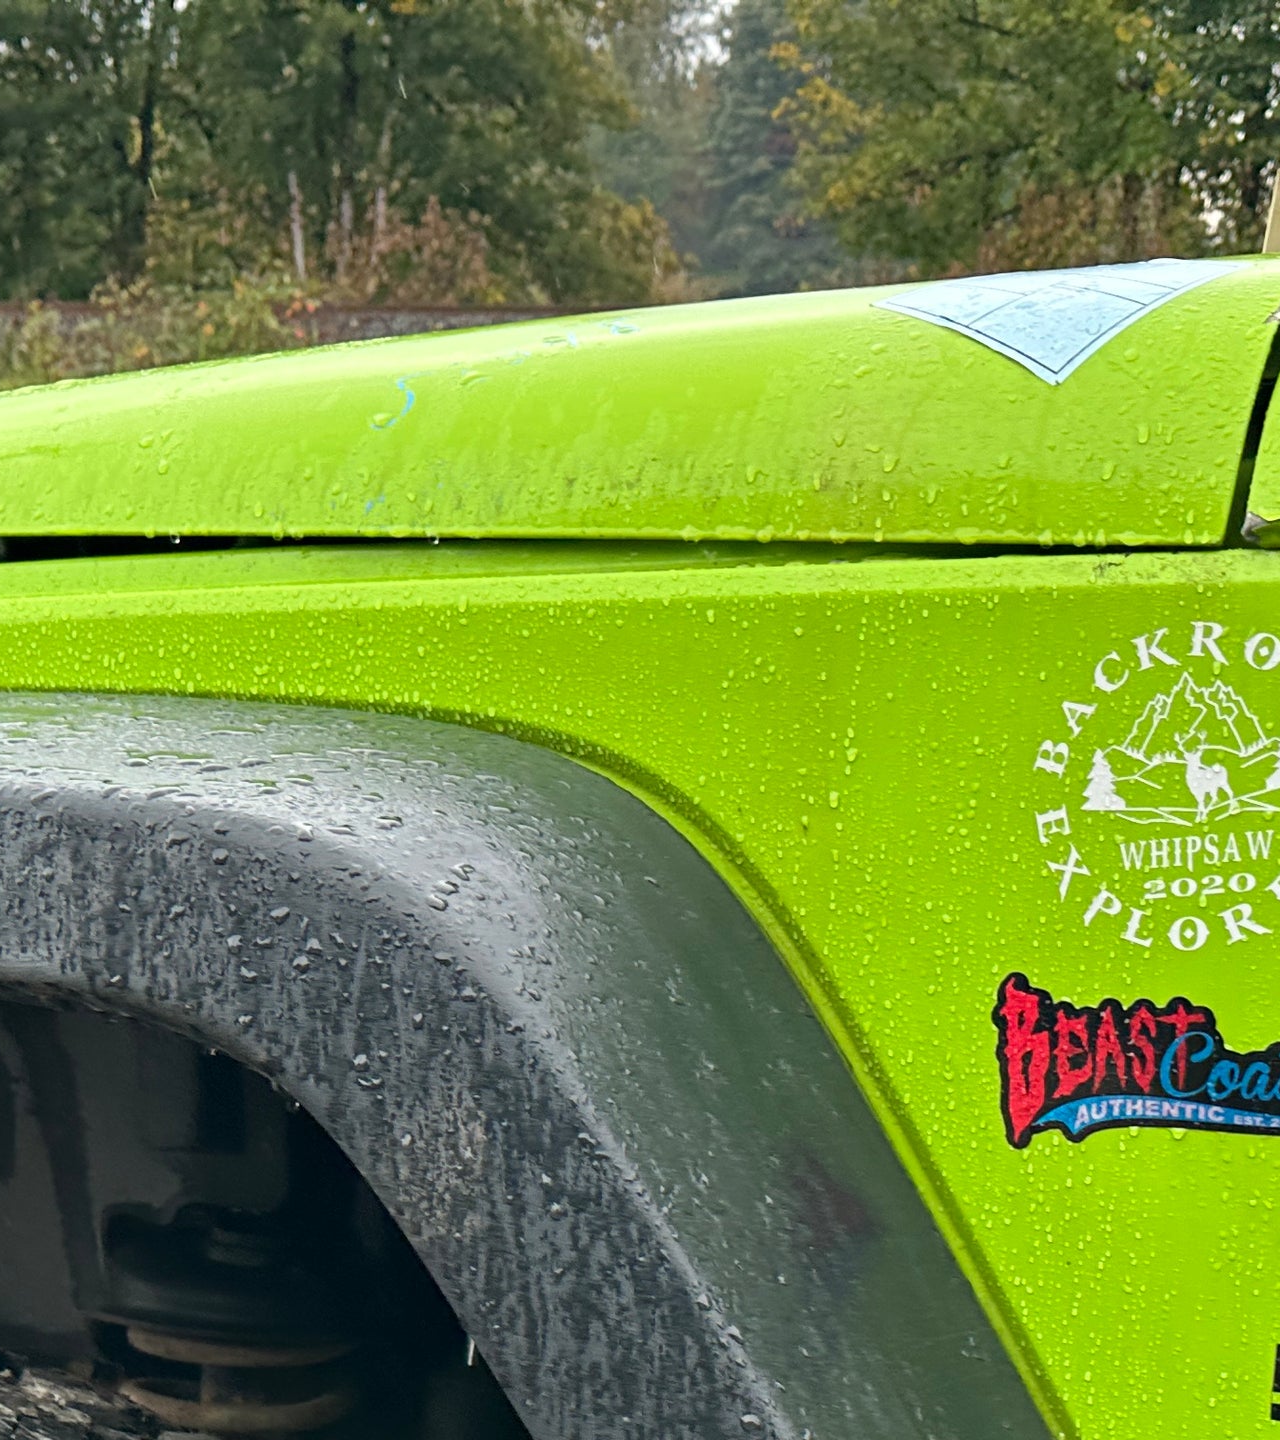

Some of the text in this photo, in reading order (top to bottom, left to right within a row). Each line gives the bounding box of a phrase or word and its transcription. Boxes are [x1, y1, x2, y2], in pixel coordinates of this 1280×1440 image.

[1120, 829, 1274, 872] WHIPSAW
[1143, 872, 1256, 899] 2020
[1000, 977, 1206, 1143] BEAST
[1074, 1099, 1226, 1129] AUTHENTIC
